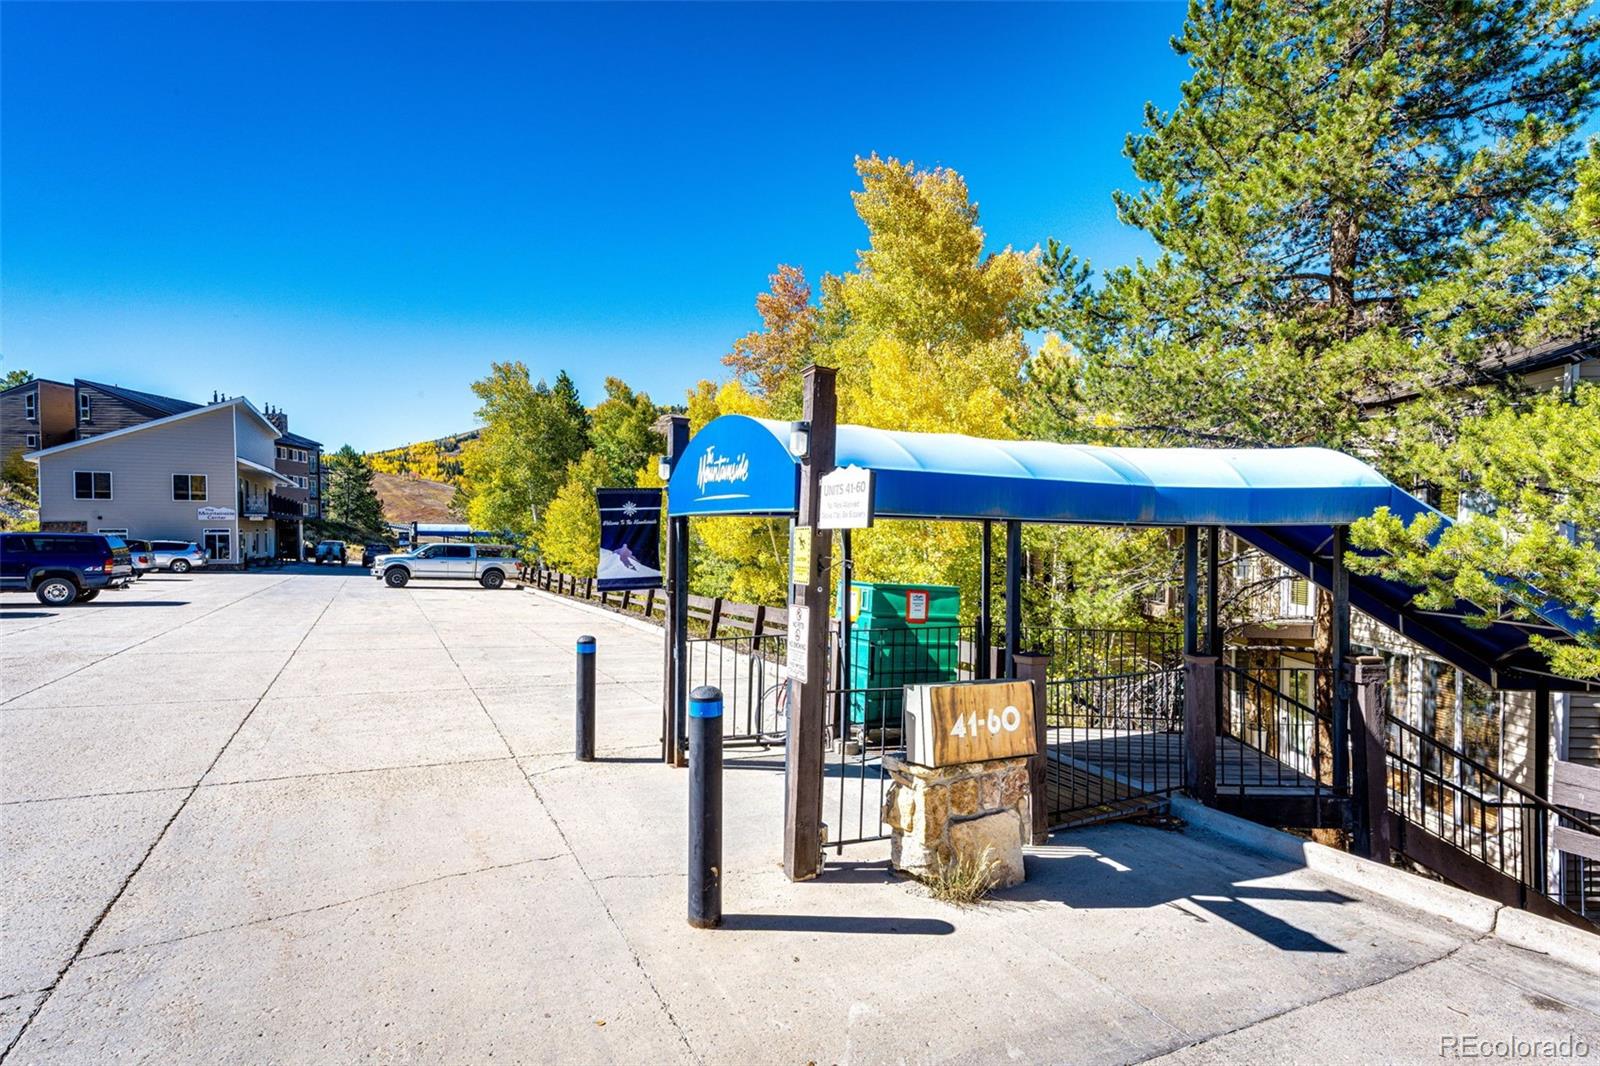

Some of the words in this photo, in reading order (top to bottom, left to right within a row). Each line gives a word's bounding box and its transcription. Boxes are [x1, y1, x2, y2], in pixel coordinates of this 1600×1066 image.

[697, 452, 749, 495] Mountainside
[823, 483, 844, 497] UNITS
[845, 480, 867, 494] 41-60
[950, 705, 1021, 738] 41-60
